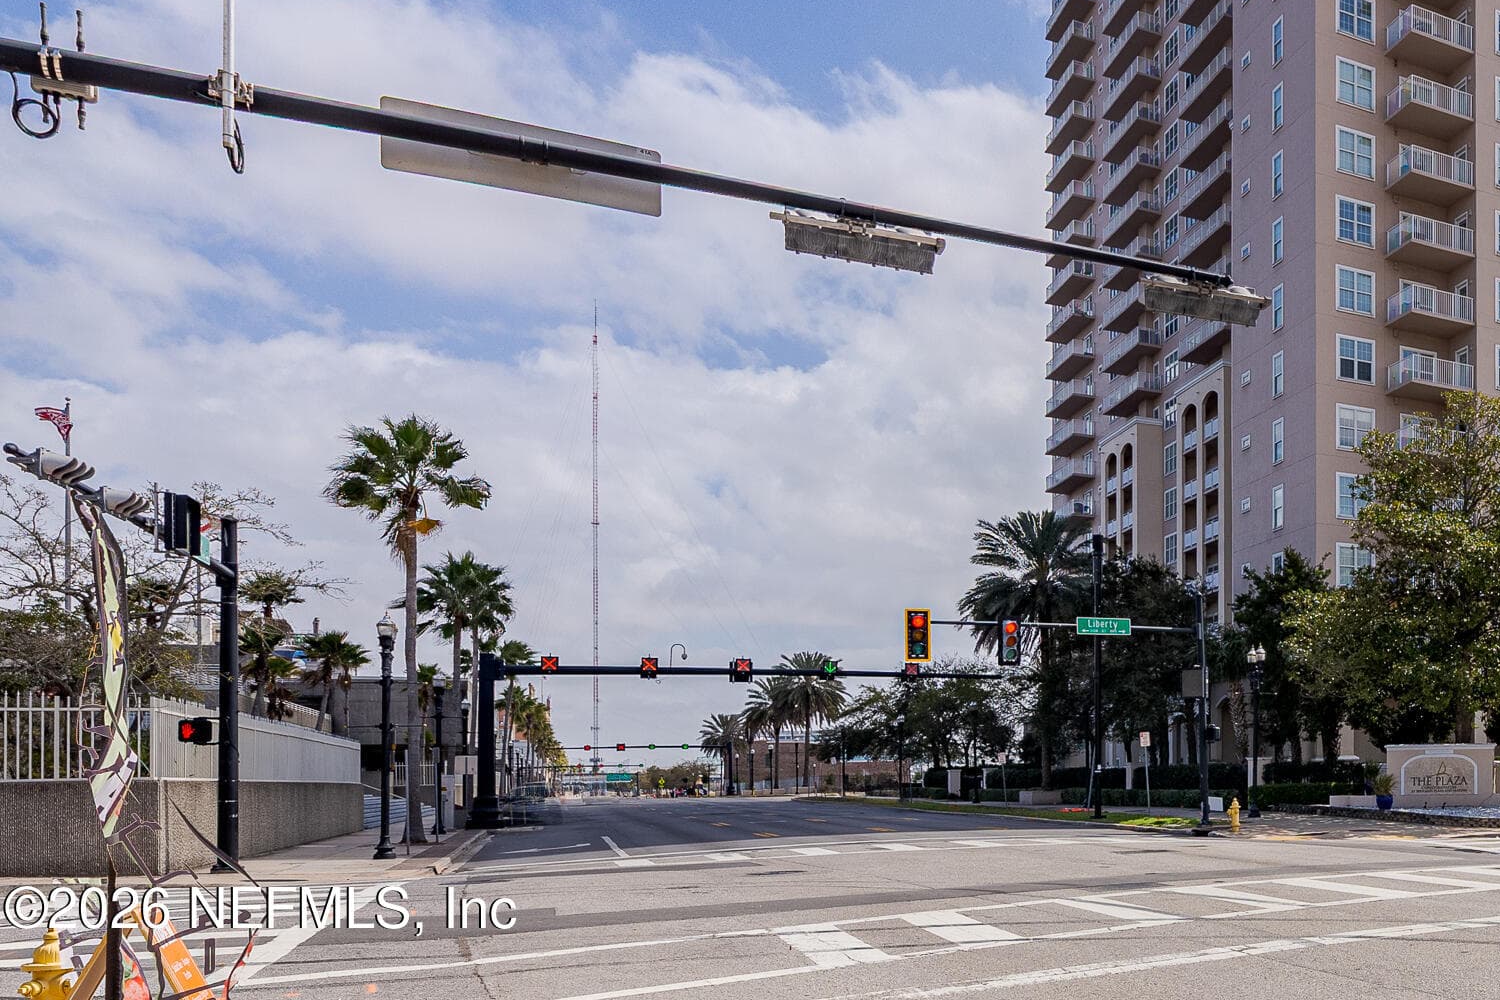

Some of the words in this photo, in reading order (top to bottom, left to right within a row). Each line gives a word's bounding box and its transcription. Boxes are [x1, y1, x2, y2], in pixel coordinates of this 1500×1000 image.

[1087, 619, 1118, 631] Liberty
[1410, 776, 1432, 786] THE
[1435, 775, 1468, 786] PLAZA
